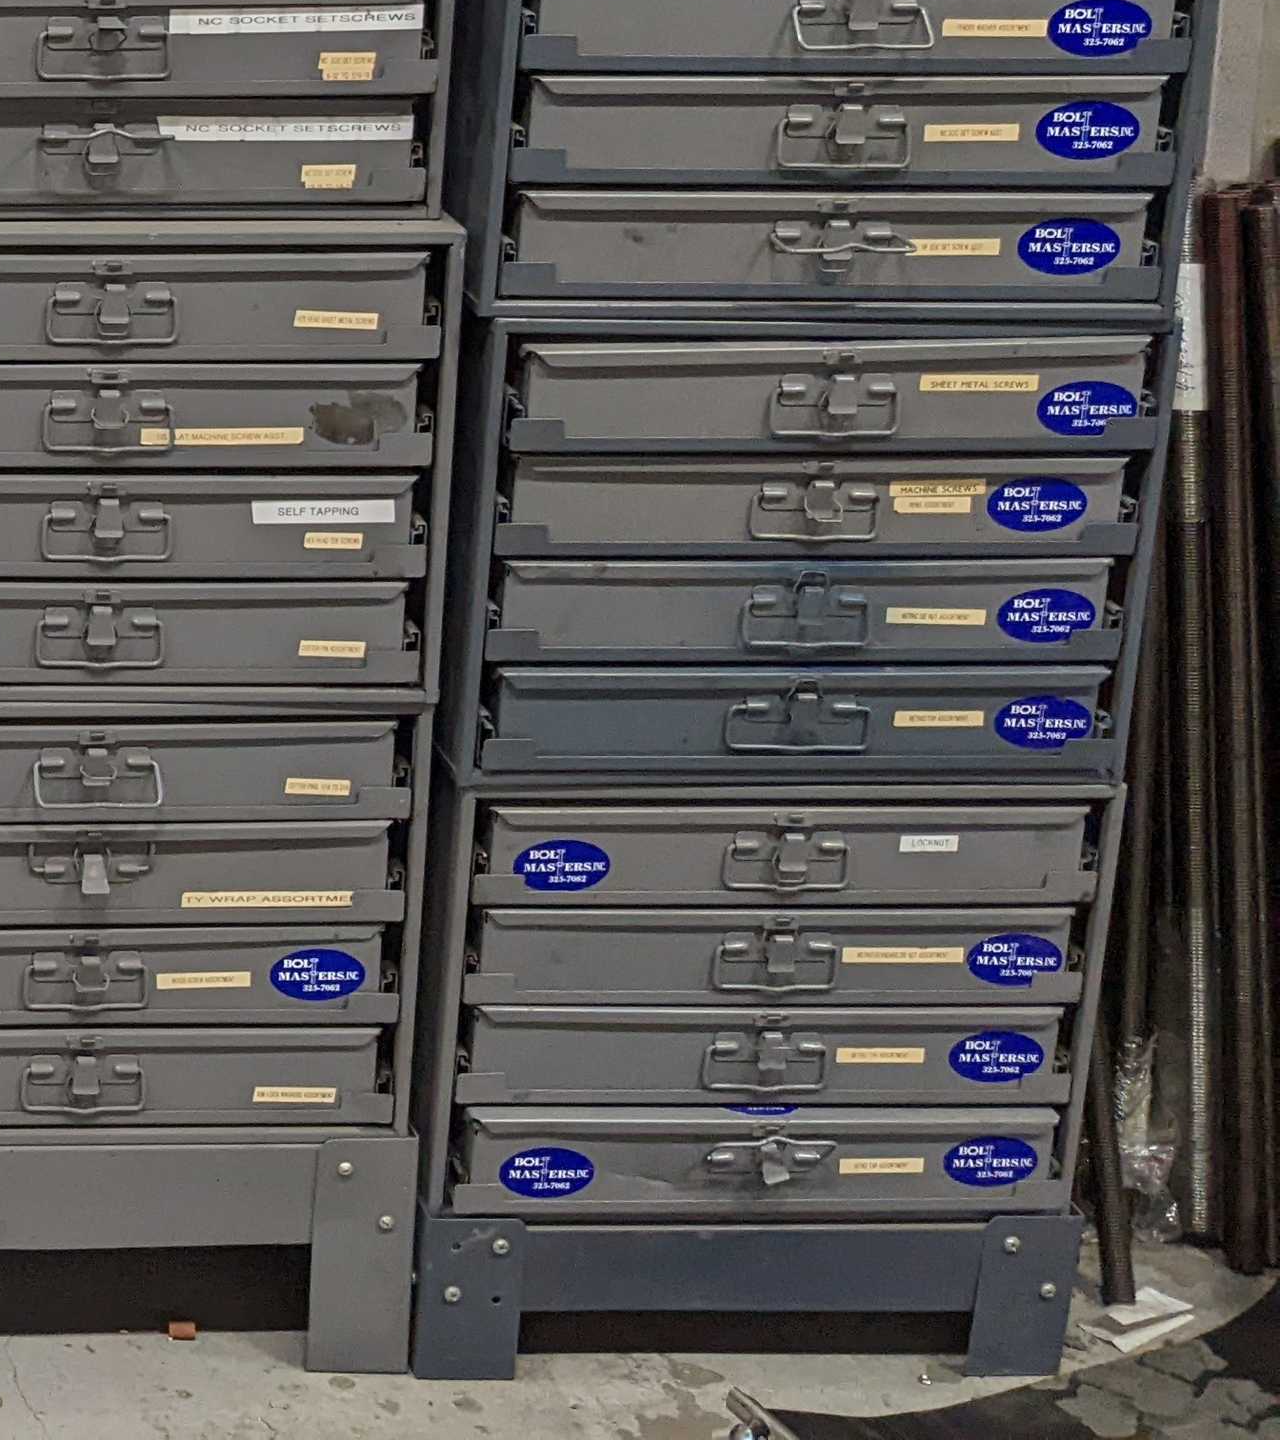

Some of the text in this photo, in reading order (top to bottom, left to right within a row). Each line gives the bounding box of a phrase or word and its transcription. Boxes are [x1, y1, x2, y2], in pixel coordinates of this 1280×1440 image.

[198, 12, 416, 26] NC SOCKET SETSCREWS
[930, 380, 1029, 389] SHEET METAL SCREWS
[277, 506, 360, 517] SELF TAPPING
[184, 895, 204, 904] TY
[209, 895, 256, 903] WRAP
[976, 1168, 1014, 1178] 325-7062
